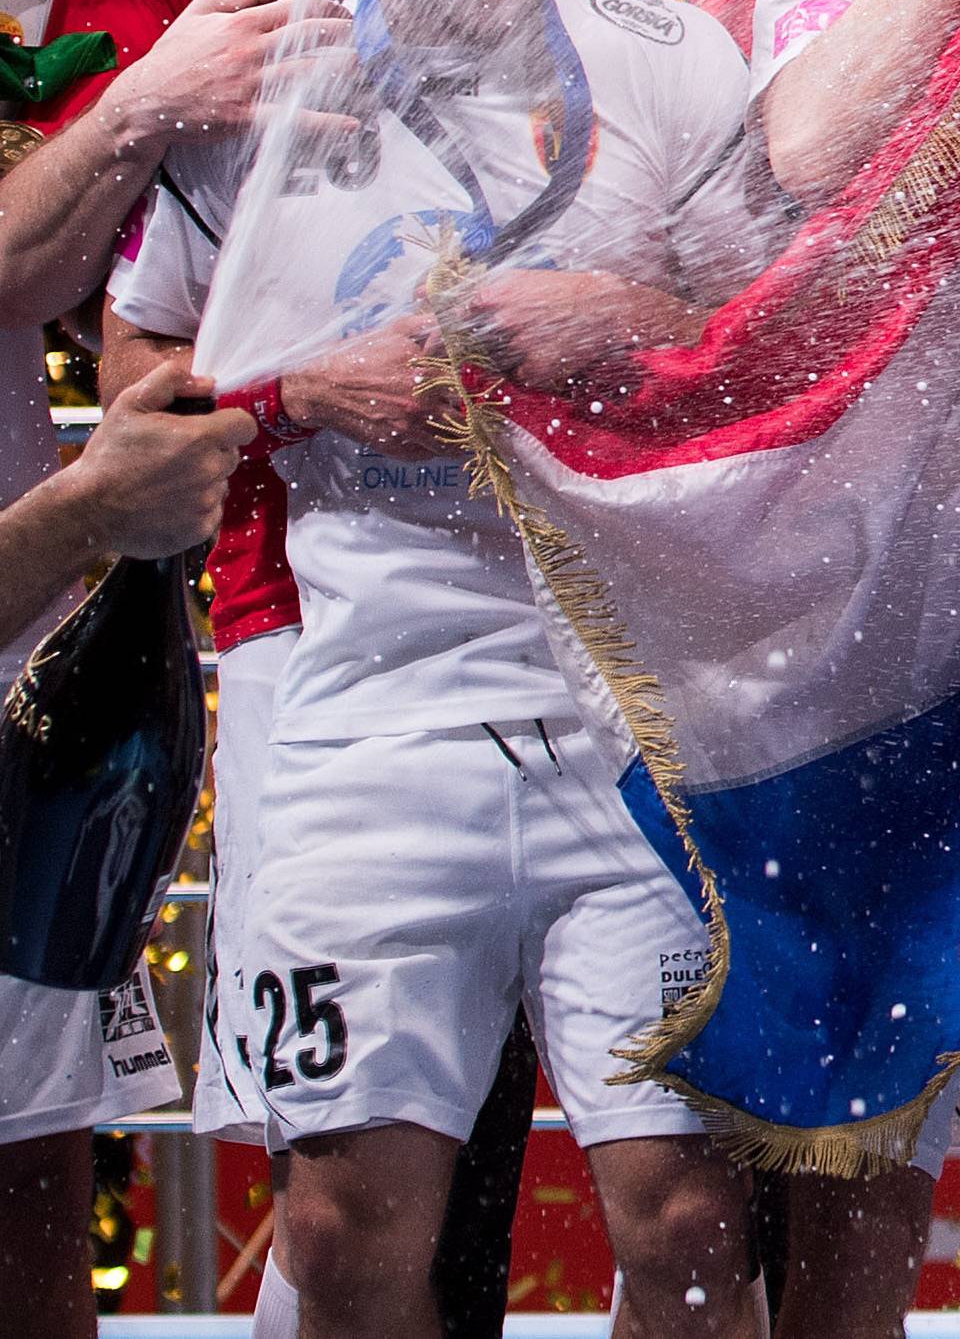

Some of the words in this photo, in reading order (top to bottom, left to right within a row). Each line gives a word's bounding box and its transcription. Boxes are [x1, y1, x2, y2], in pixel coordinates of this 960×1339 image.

[363, 466, 460, 490] ONLINE
[253, 962, 349, 1093] 25
[108, 1042, 173, 1078] hummel
